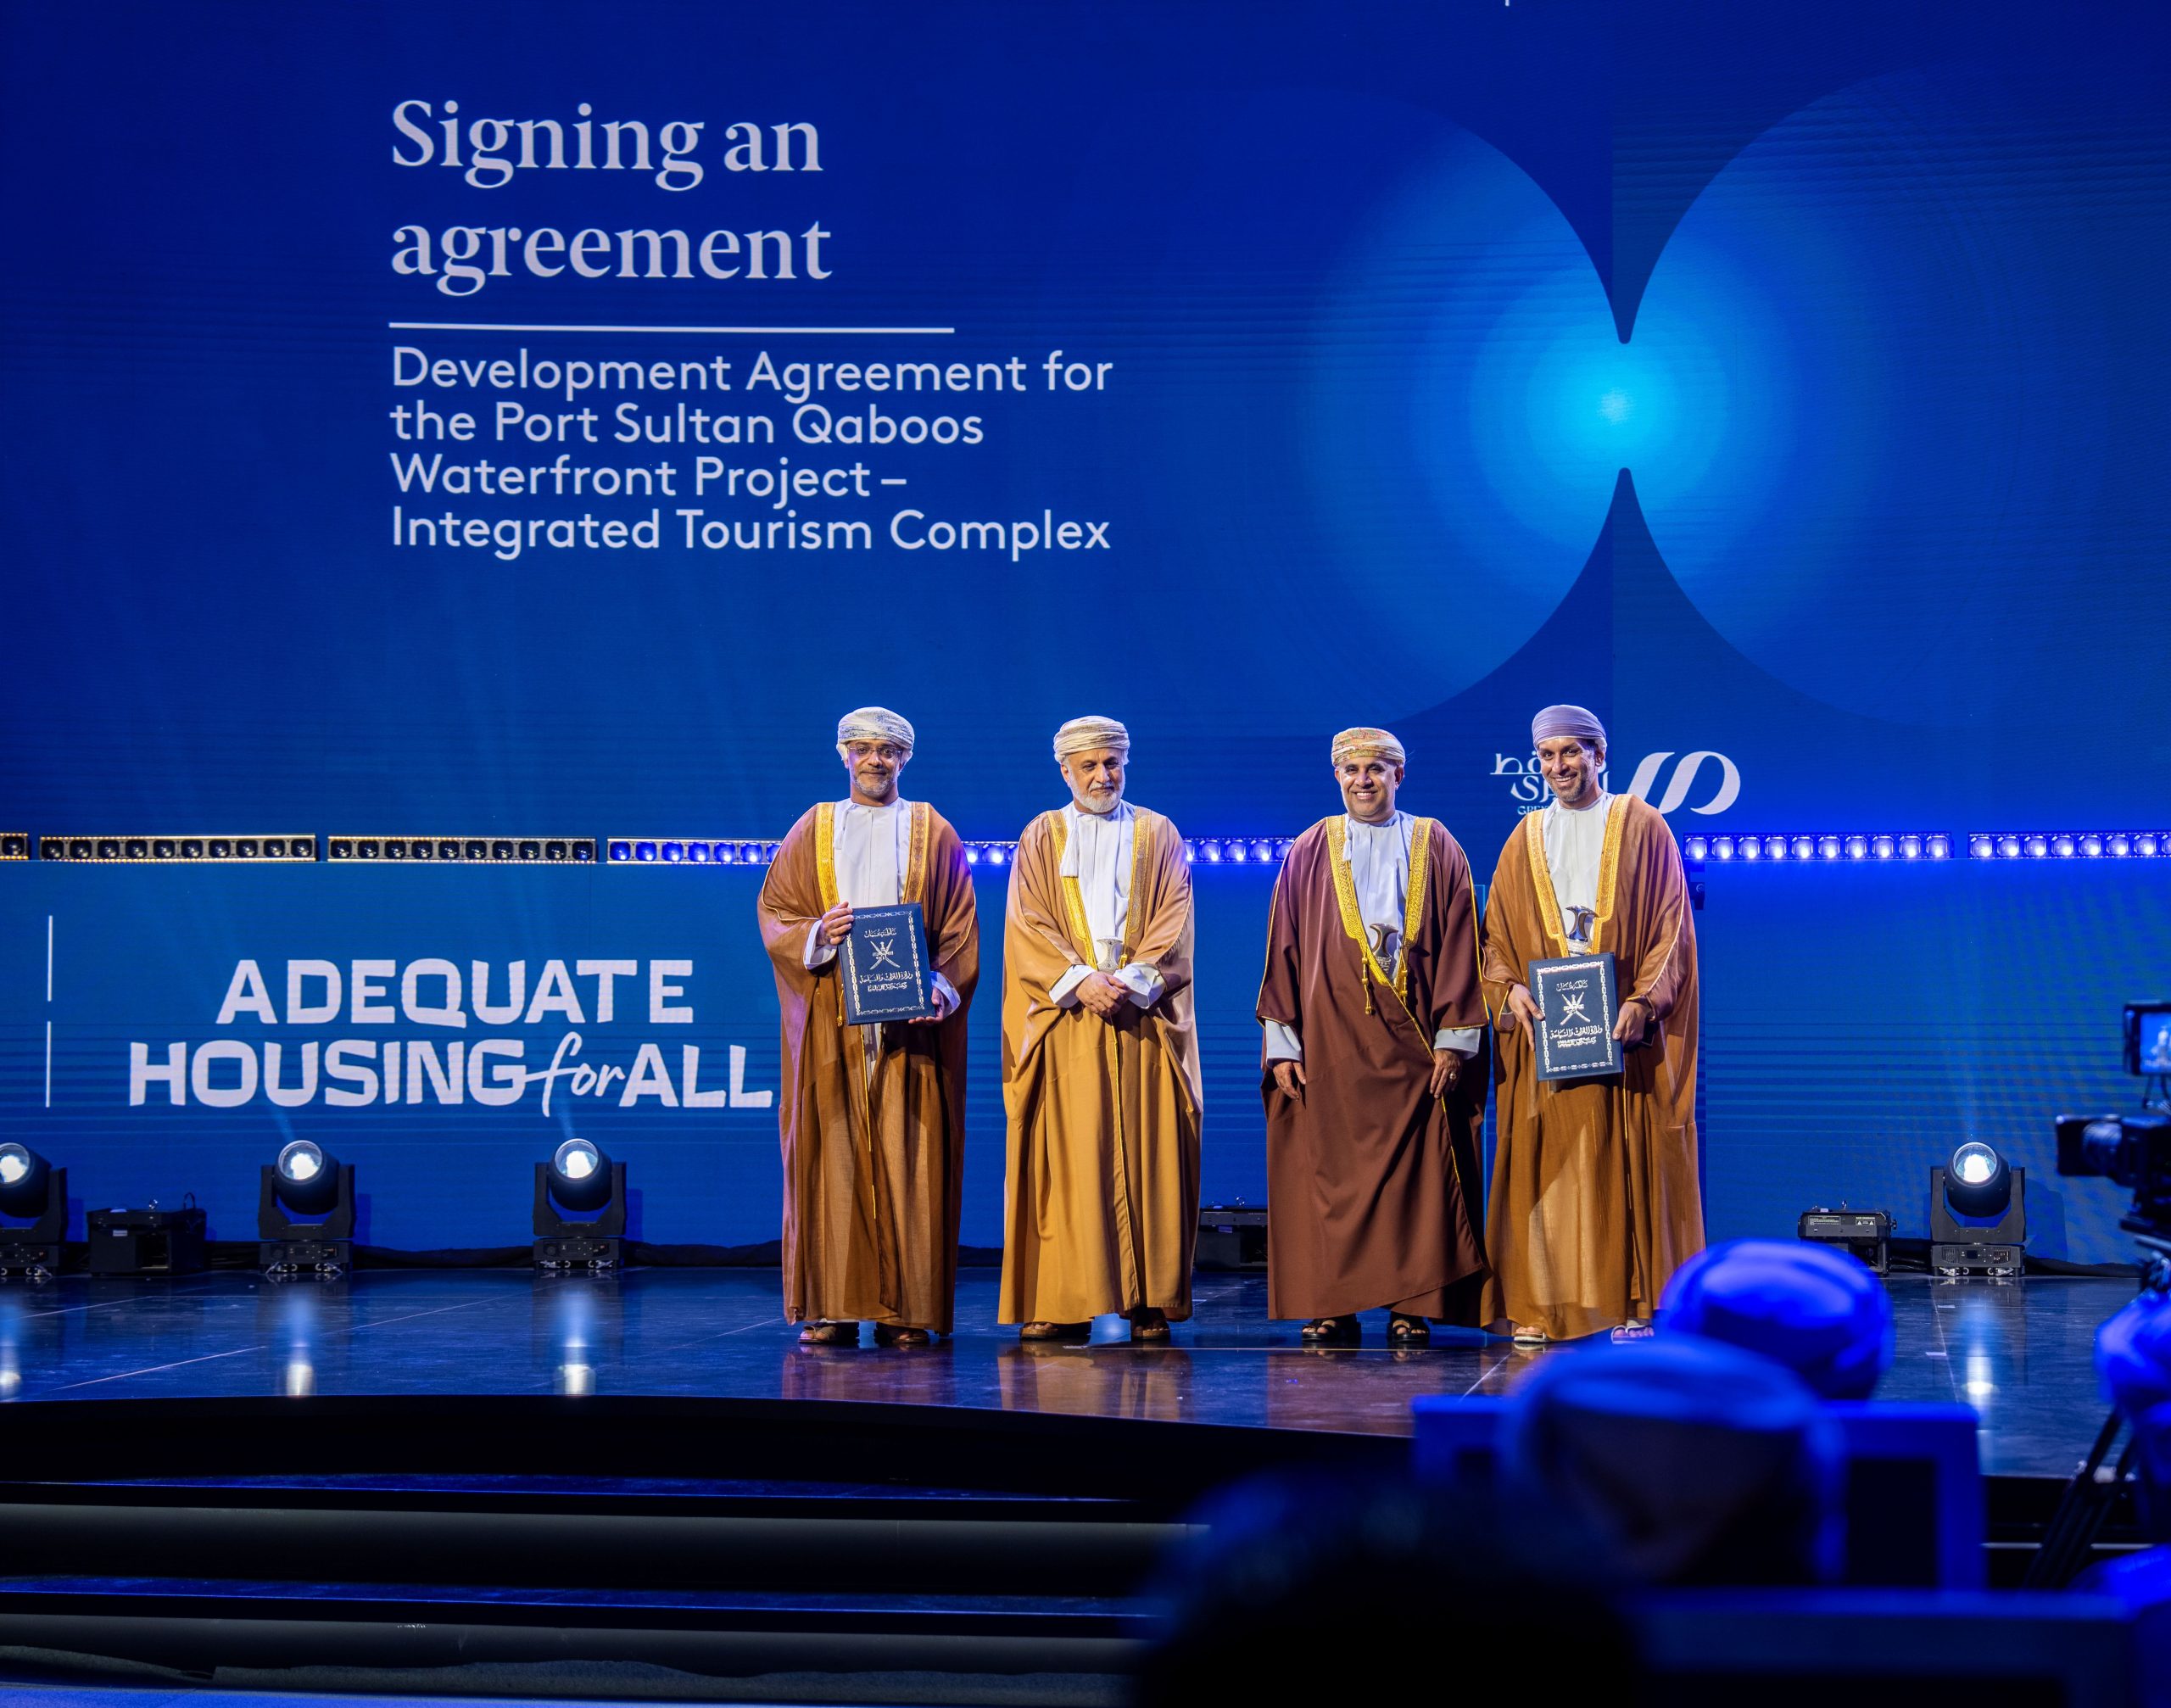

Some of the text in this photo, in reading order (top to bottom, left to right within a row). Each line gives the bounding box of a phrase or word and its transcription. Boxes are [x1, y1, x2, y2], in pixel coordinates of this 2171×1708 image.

[393, 100, 823, 192] Signing an
[391, 220, 833, 297] agreement
[393, 347, 1113, 405] Development Agreement for
[389, 399, 984, 444] the Port Sultan Qaboos
[390, 453, 677, 496] Waterfront
[696, 456, 870, 510] Project
[393, 505, 1110, 562] Integrated Tourism Complex
[216, 958, 694, 1029] ADEQUATE
[129, 1030, 773, 1118] HOUSING for ALL
